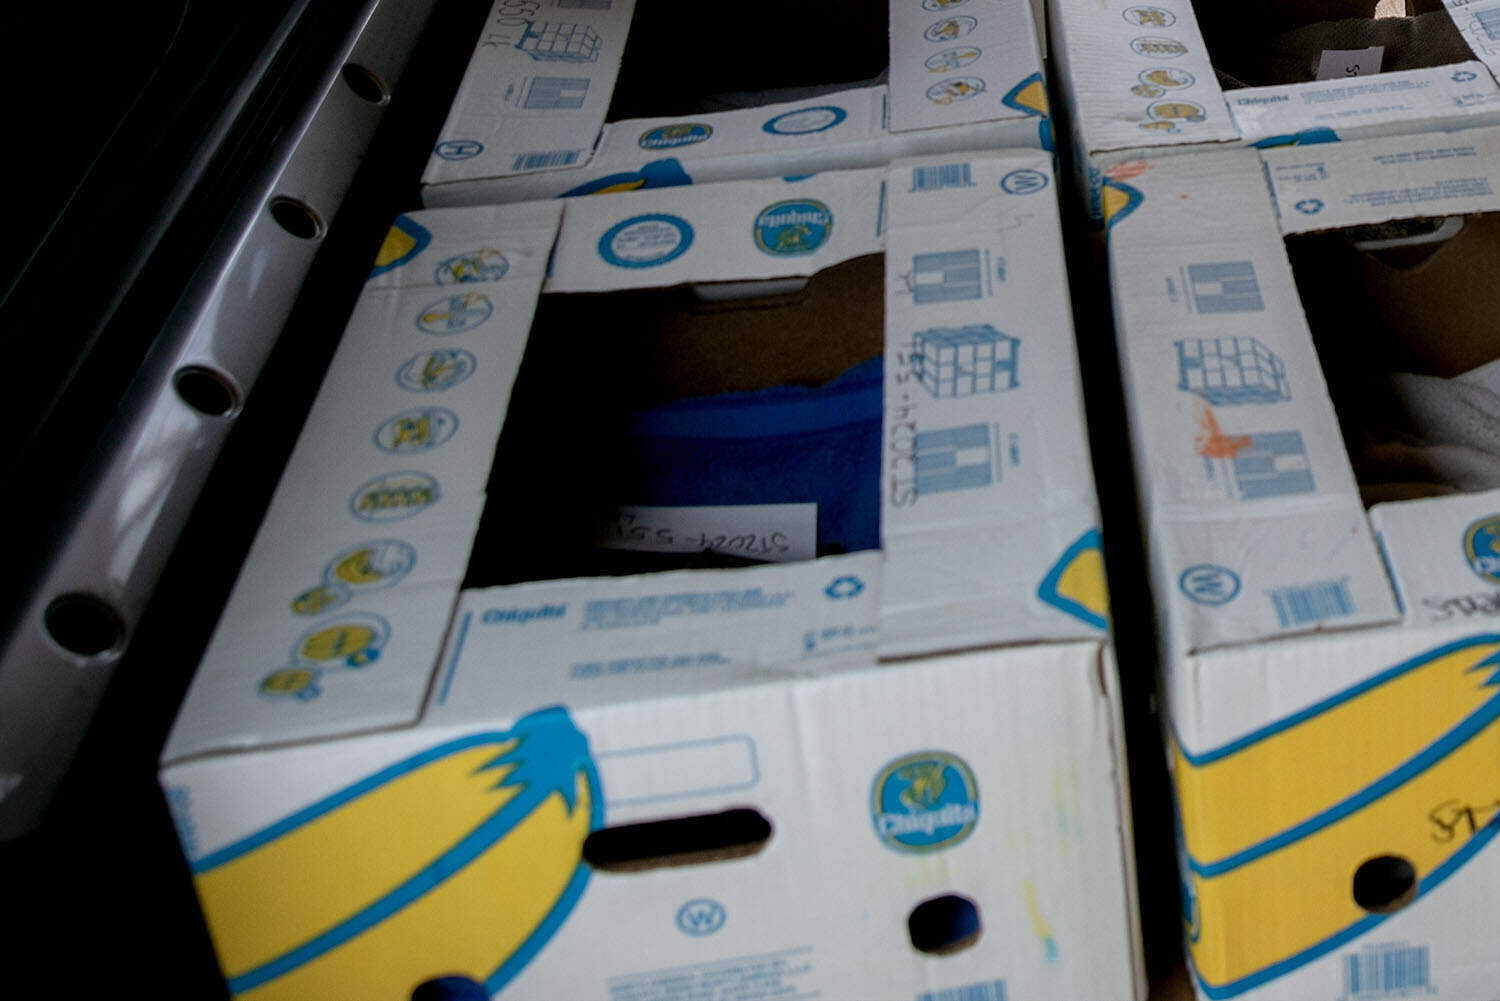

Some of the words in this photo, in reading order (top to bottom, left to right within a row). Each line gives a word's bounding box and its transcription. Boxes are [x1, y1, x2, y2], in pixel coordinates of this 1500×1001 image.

[641, 134, 708, 147] Chiquita
[759, 210, 829, 230] Chiquita
[482, 604, 567, 625] Chiquita
[876, 800, 977, 836] Chiquita
